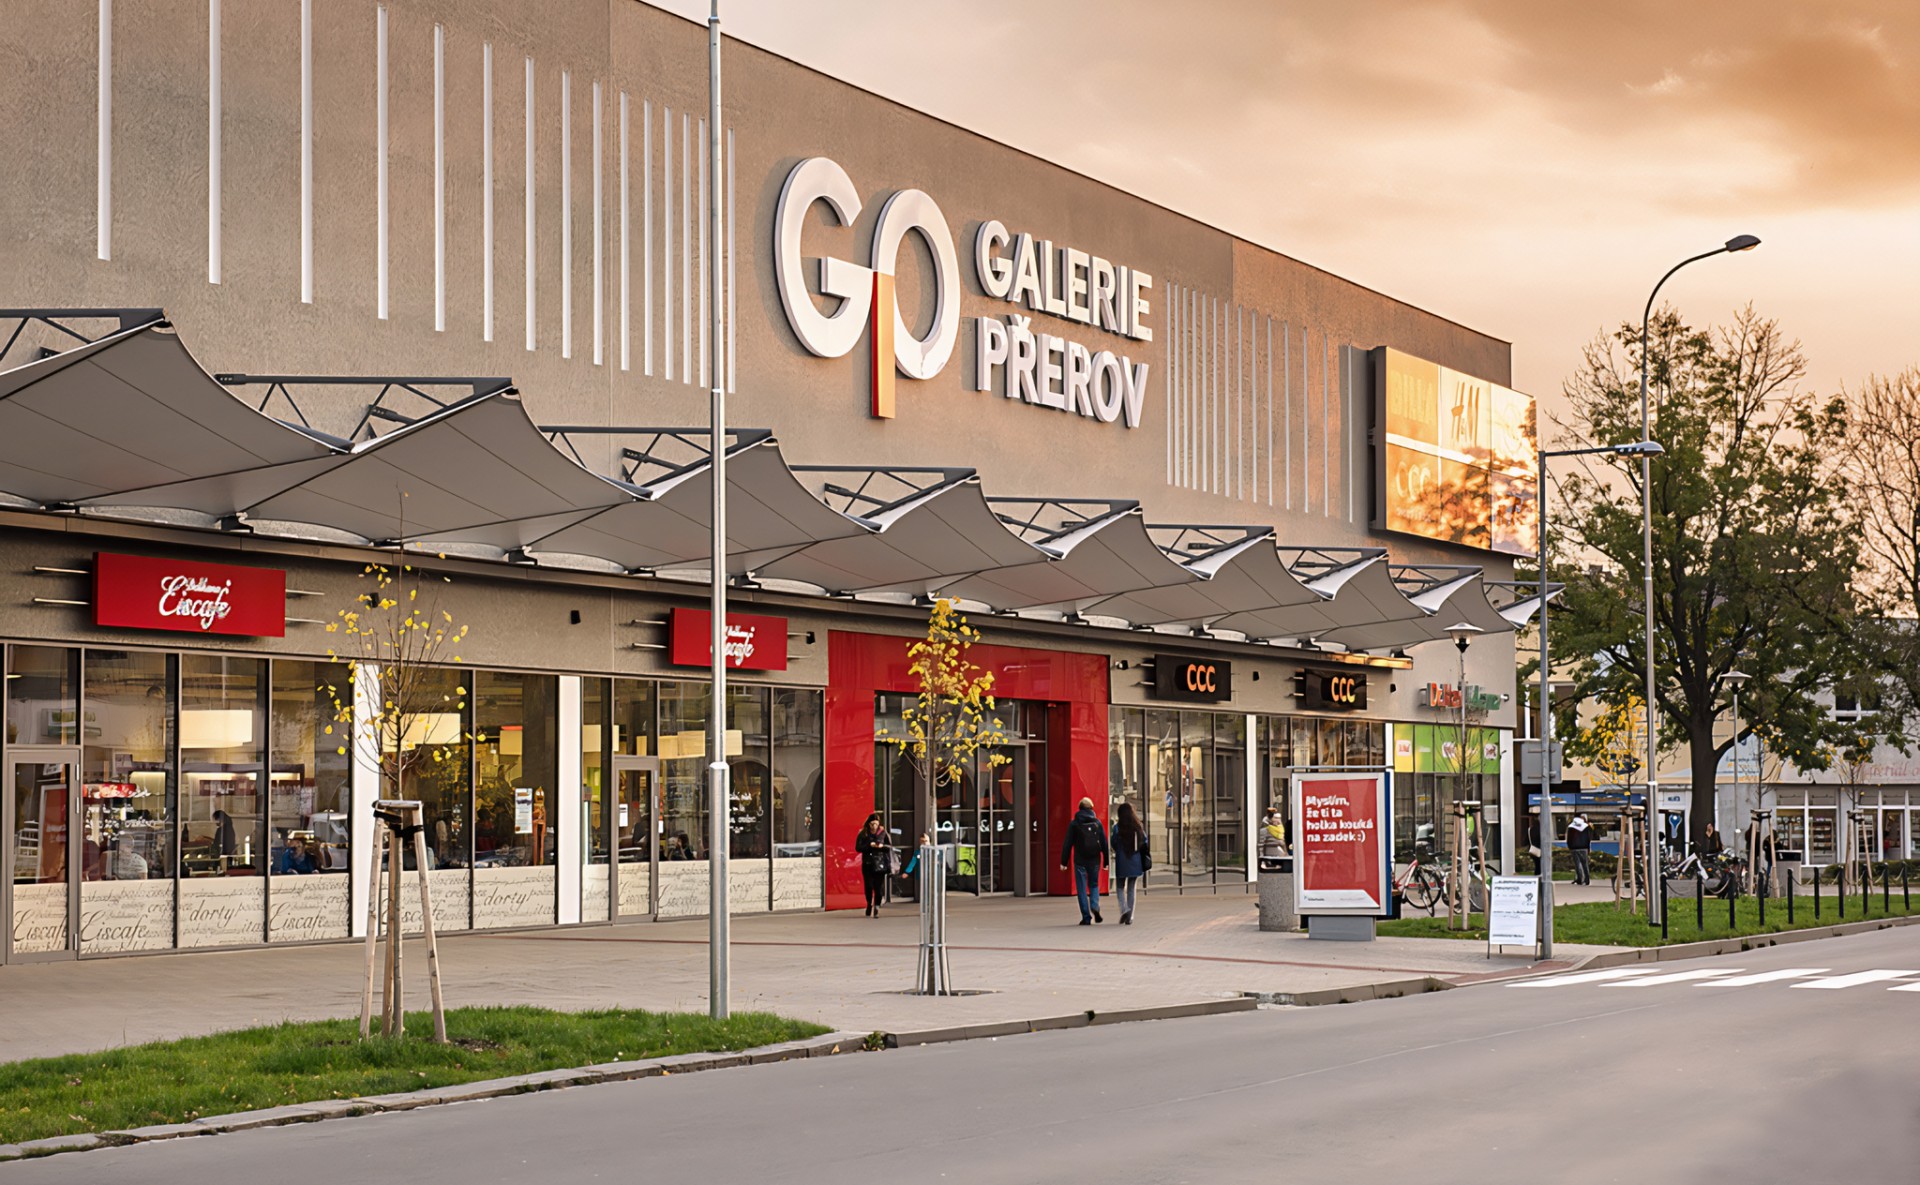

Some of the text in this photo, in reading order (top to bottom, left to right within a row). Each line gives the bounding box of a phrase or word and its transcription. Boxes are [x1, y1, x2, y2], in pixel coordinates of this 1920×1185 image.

[975, 219, 1153, 342] GALERIE
[975, 313, 1149, 428] PŘEROV
[1187, 663, 1216, 693] CCC
[1331, 676, 1356, 703] CCC
[1306, 819, 1337, 830] holka
[1320, 807, 1329, 818] ti
[1331, 807, 1343, 818] ta
[1307, 834, 1320, 842] na
[1323, 831, 1356, 843] zadek
[80, 909, 148, 947] Eiscafe
[189, 899, 235, 928] dorty
